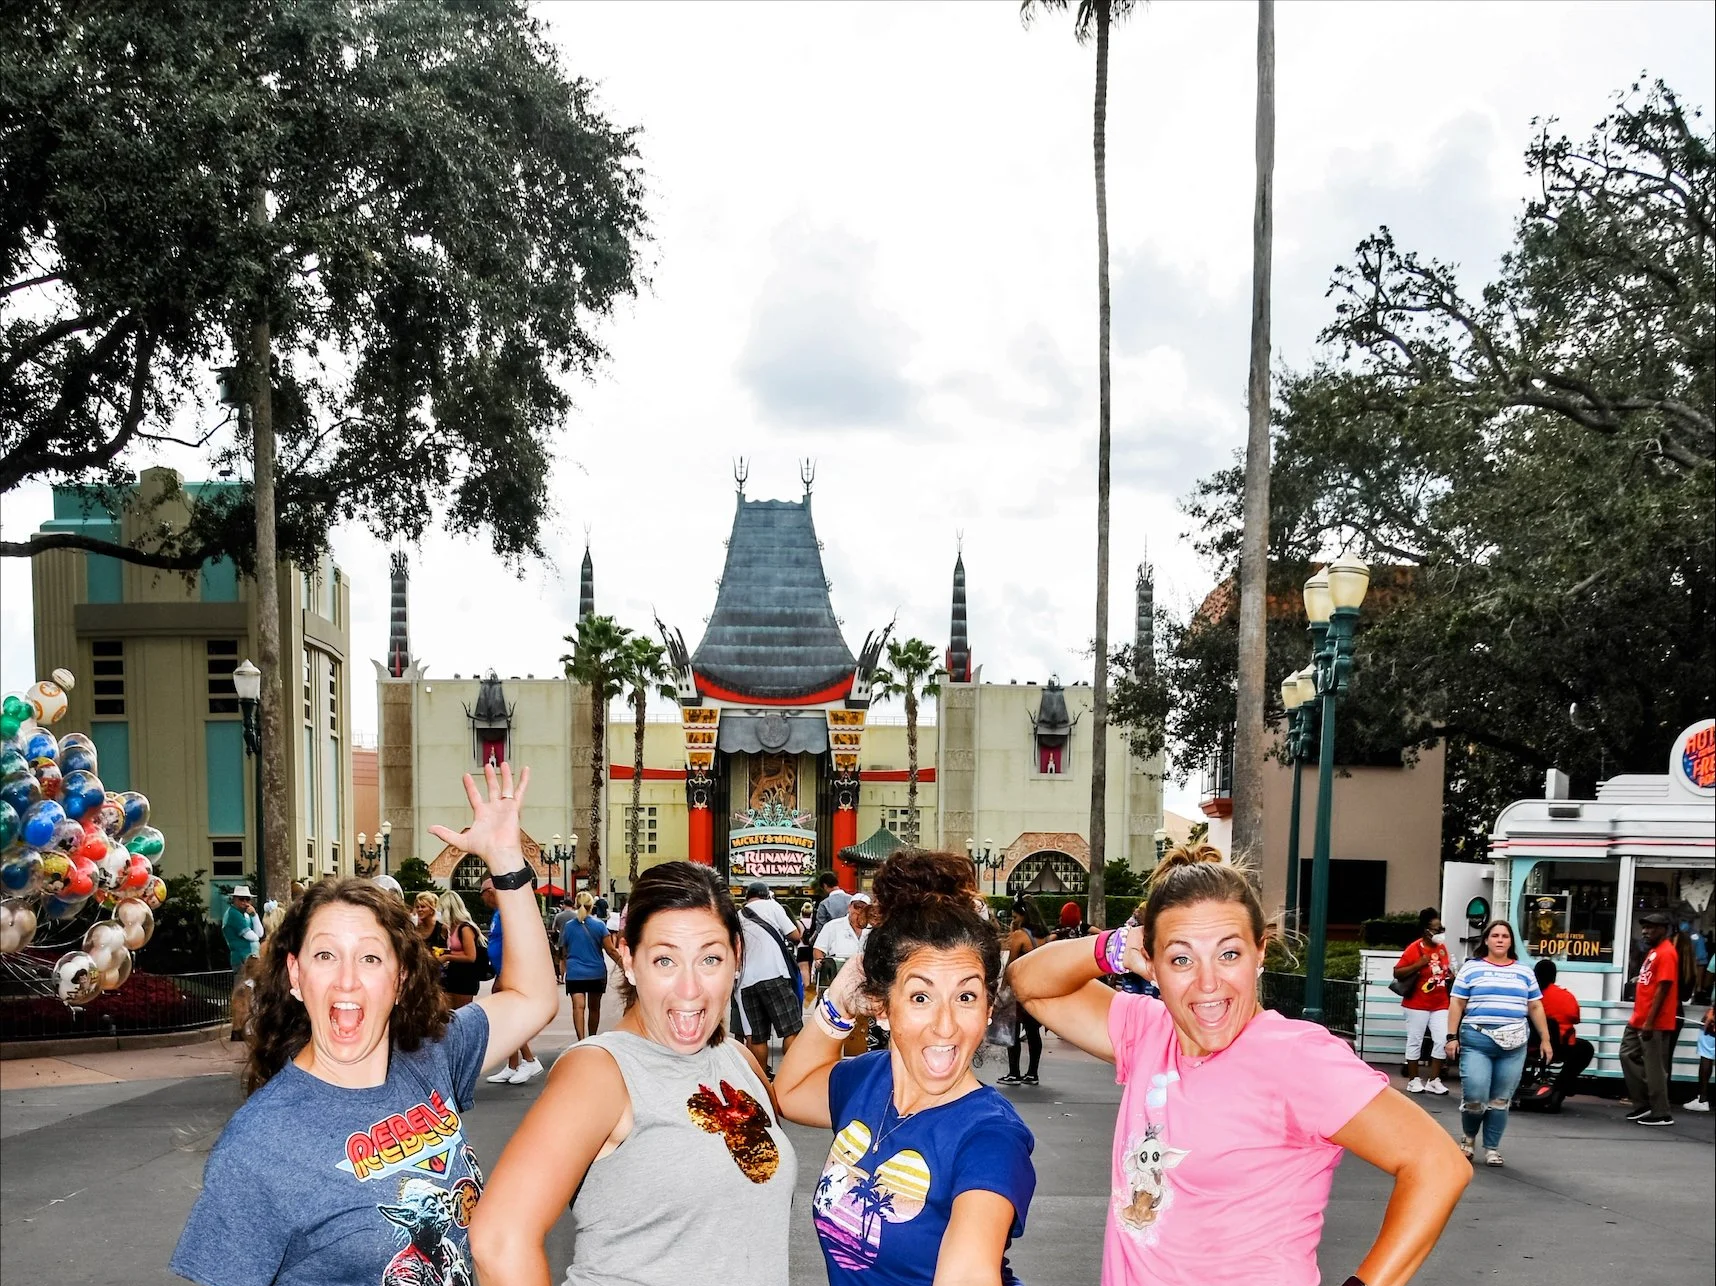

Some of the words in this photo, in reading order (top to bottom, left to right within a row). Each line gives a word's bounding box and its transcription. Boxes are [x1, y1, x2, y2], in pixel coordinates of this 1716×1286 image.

[732, 835, 765, 847] MICKEY
[744, 851, 804, 863] RUNAWAY
[745, 863, 803, 878] RAILWAY
[1540, 939, 1600, 956] POPCORN
[345, 1089, 460, 1180] REBELS
